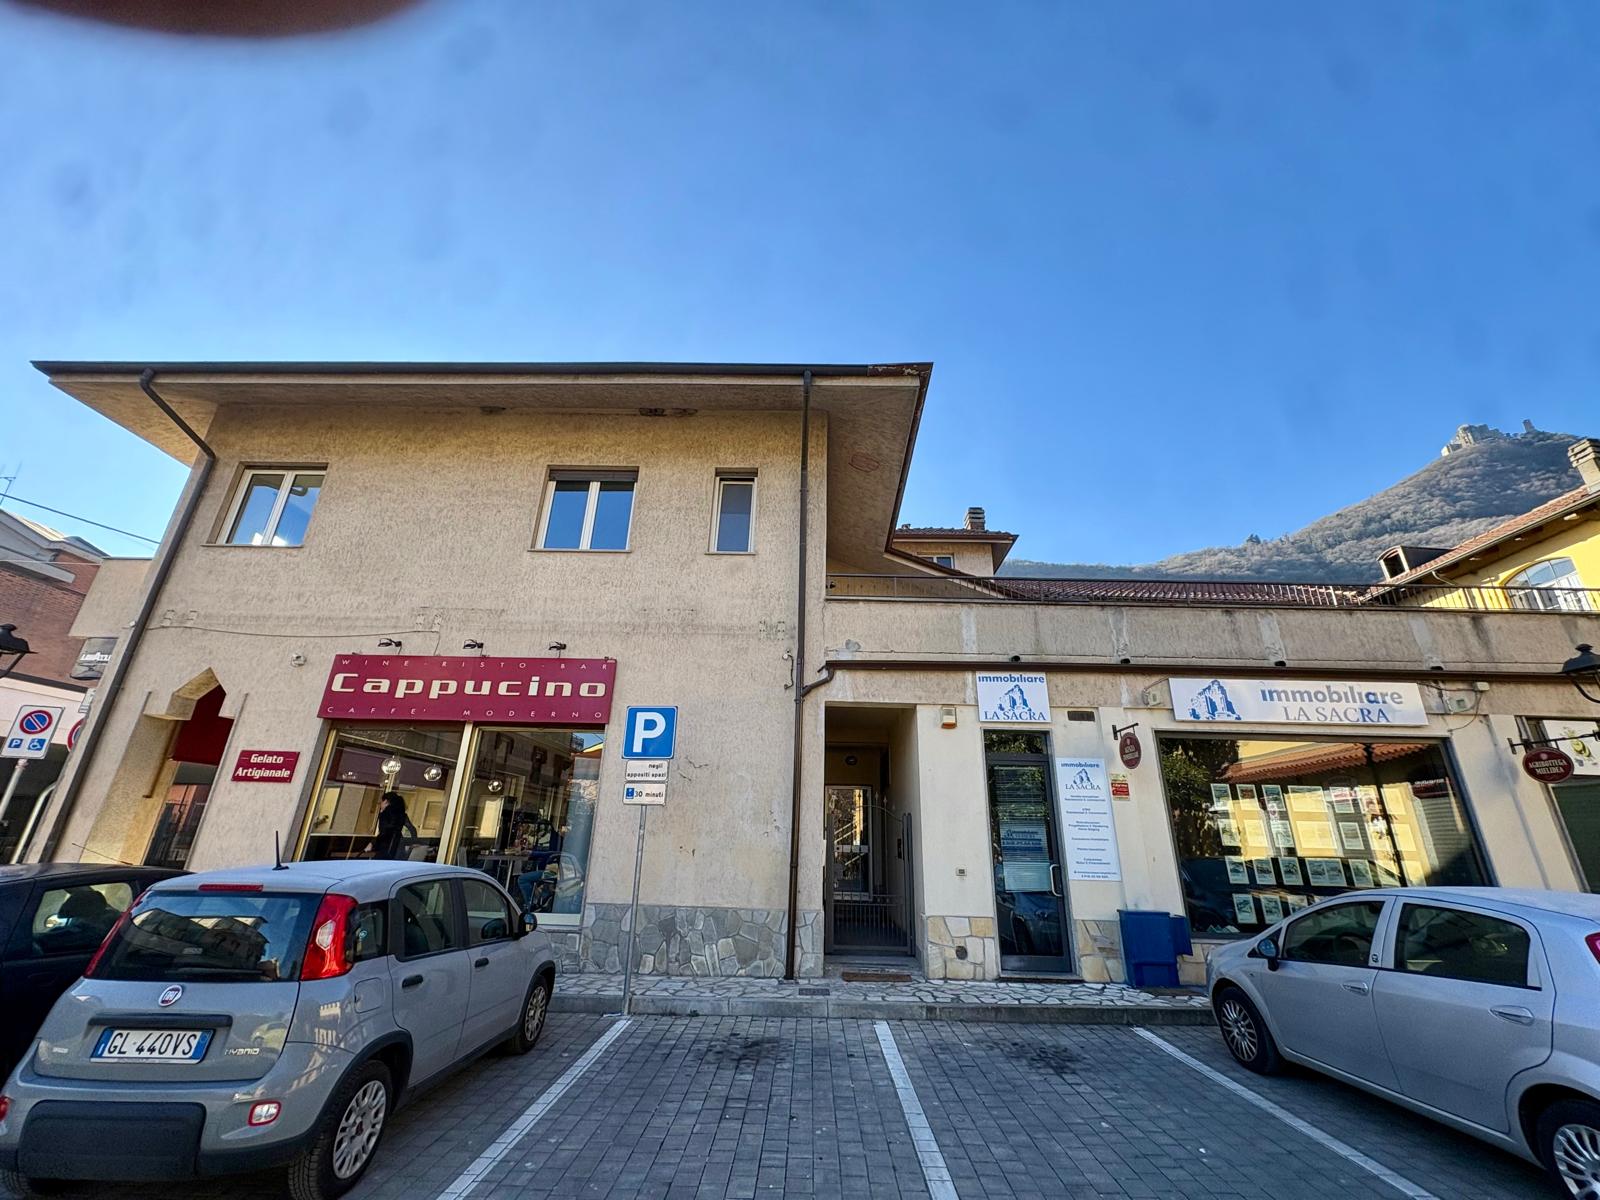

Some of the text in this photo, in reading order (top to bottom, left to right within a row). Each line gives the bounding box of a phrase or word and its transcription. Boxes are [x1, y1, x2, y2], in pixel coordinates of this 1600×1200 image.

[978, 674, 1045, 683] immobiliare
[331, 673, 606, 699] Cappucino
[1260, 685, 1403, 704] immobiliare
[327, 706, 602, 718] CAFFE' MODERNO
[984, 710, 1046, 721] LA SACRA
[1283, 706, 1391, 723] LA SACRA
[632, 711, 666, 753] P
[11, 739, 21, 748] P
[250, 753, 284, 764] Gelato
[234, 766, 291, 779] Artigianale
[107, 1032, 130, 1055] GL
